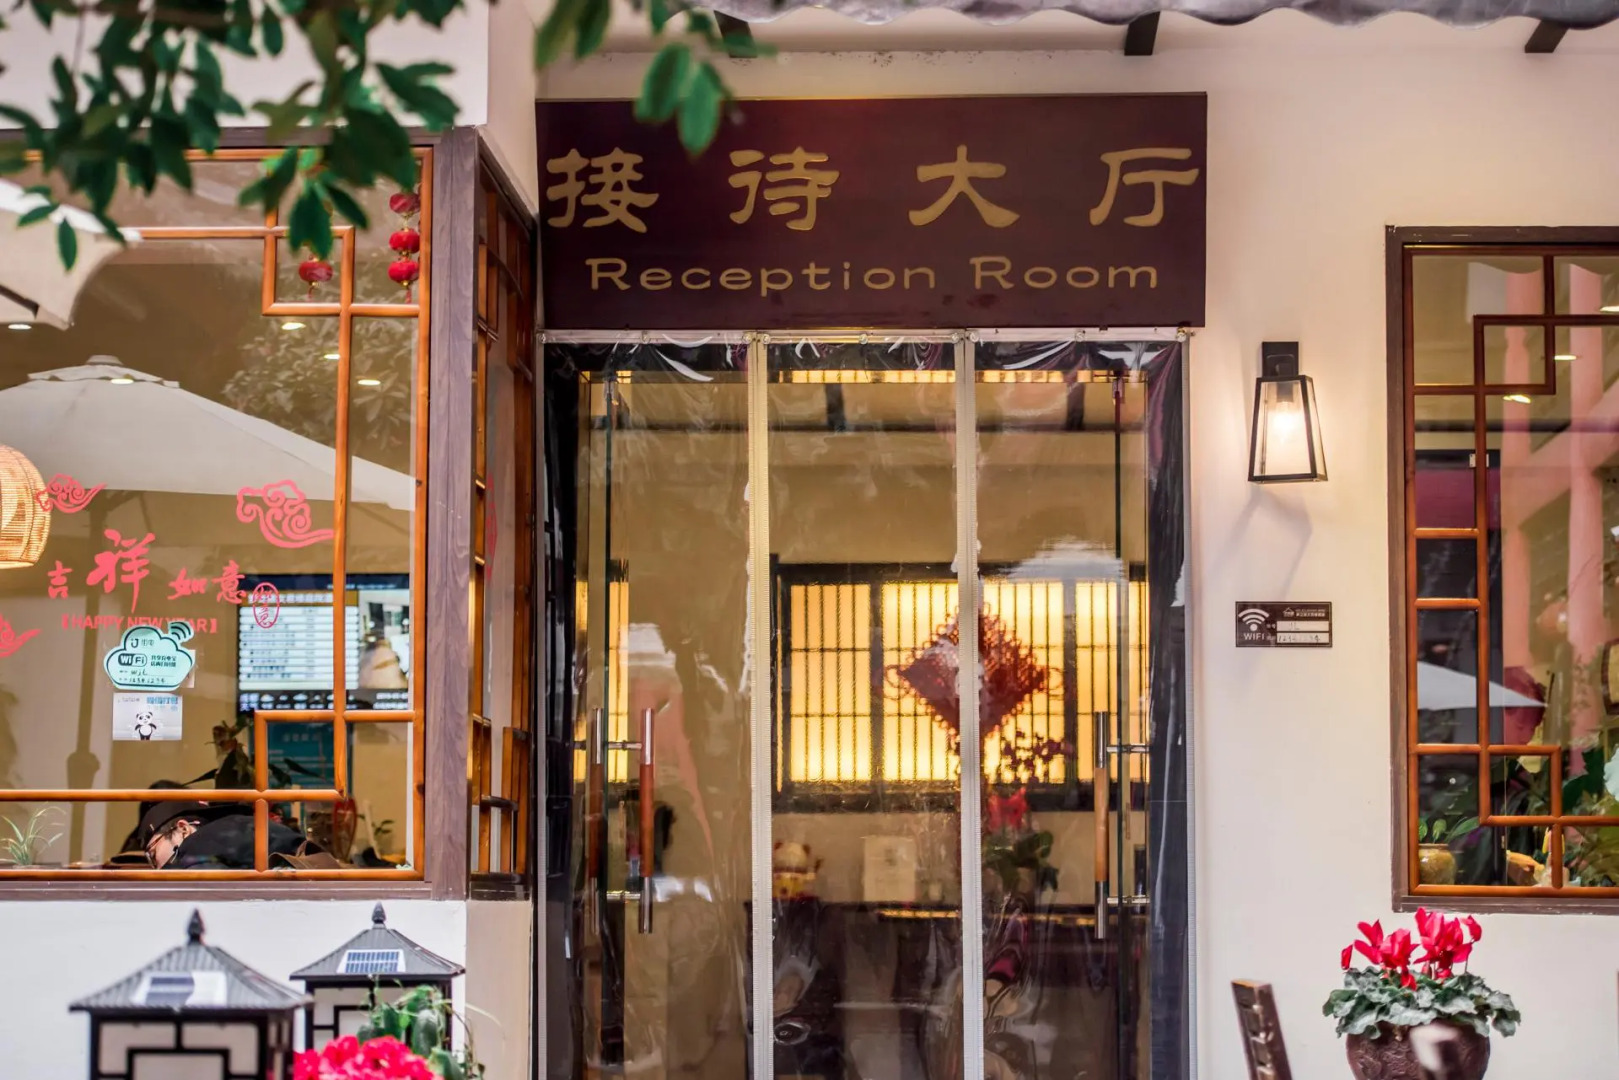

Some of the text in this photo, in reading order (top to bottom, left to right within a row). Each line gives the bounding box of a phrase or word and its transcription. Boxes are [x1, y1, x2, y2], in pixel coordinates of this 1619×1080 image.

[546, 144, 1199, 234] 接待大厅
[585, 255, 1159, 297] Reception Room
[1243, 632, 1266, 641] WIFI
